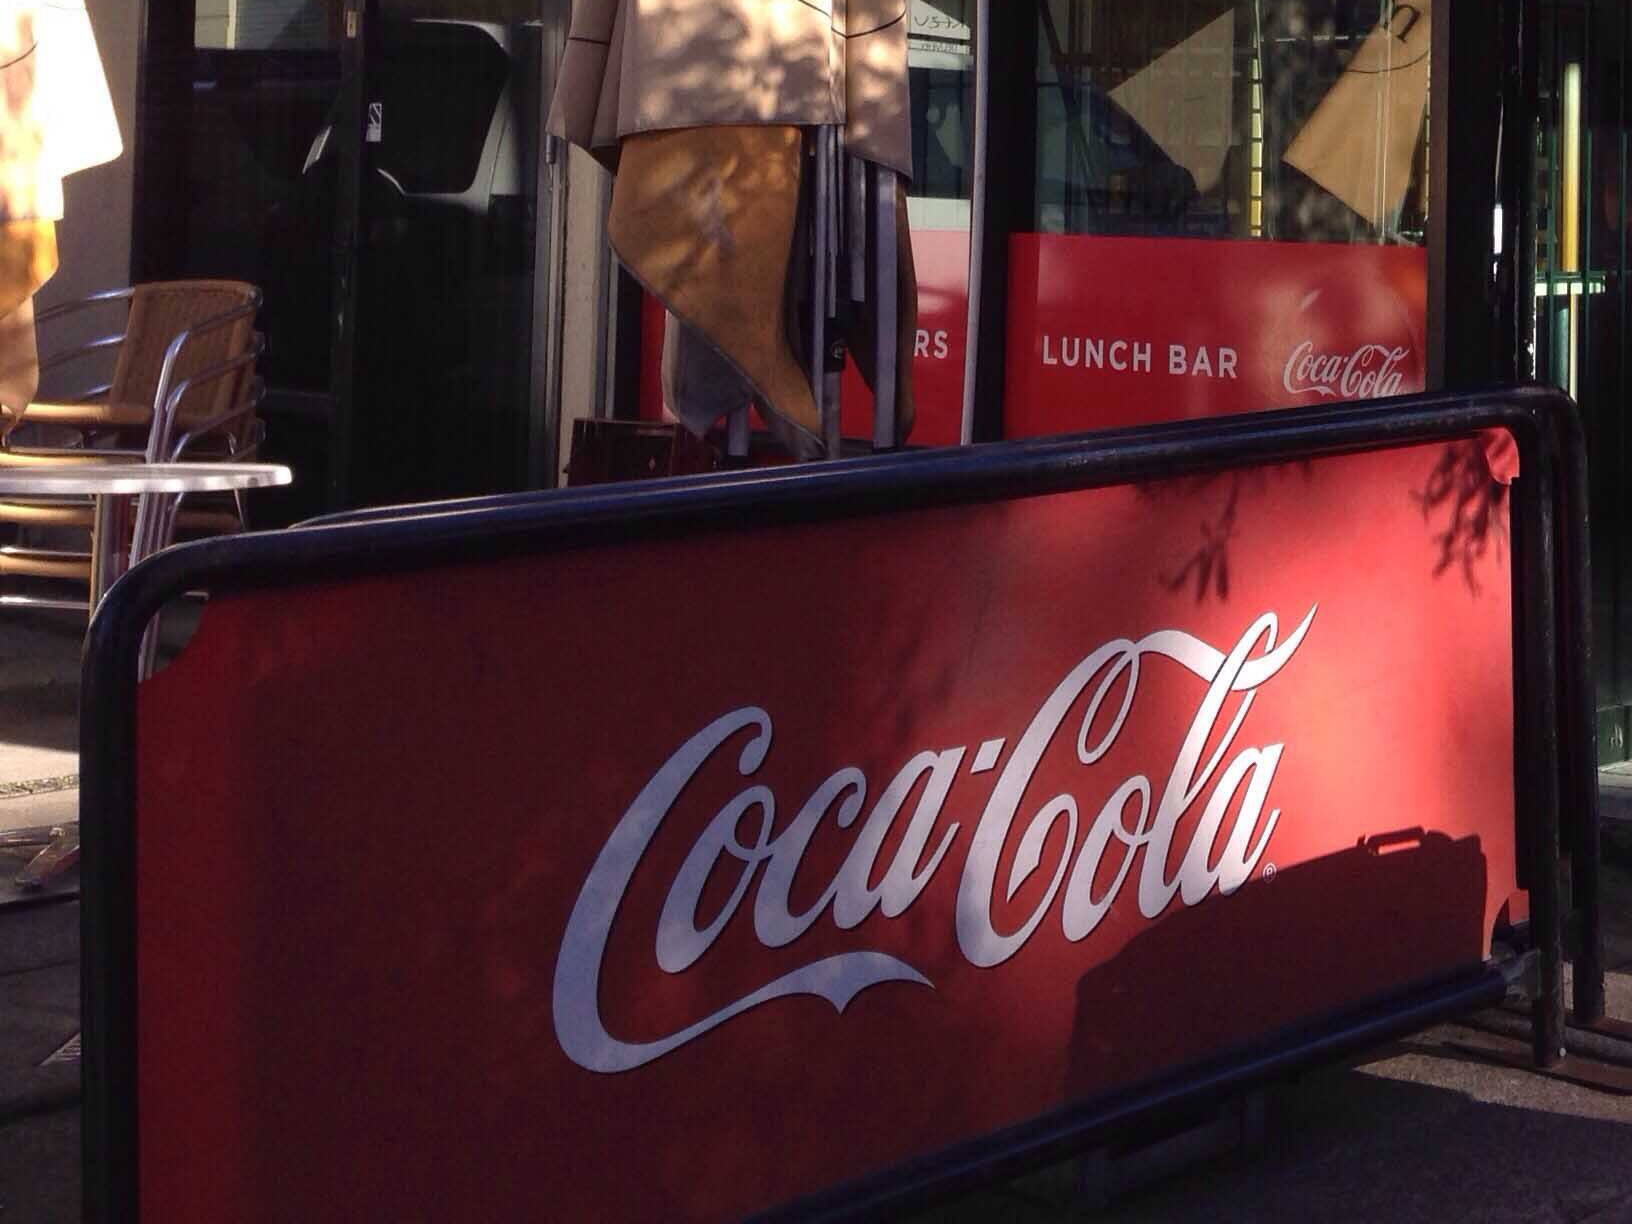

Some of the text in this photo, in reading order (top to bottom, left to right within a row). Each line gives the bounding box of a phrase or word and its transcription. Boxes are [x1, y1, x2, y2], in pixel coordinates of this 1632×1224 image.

[1042, 335, 1238, 379] LUNCH BAR
[1283, 340, 1410, 399] Coca-Cola
[552, 601, 1319, 1074] Coca-Cola
